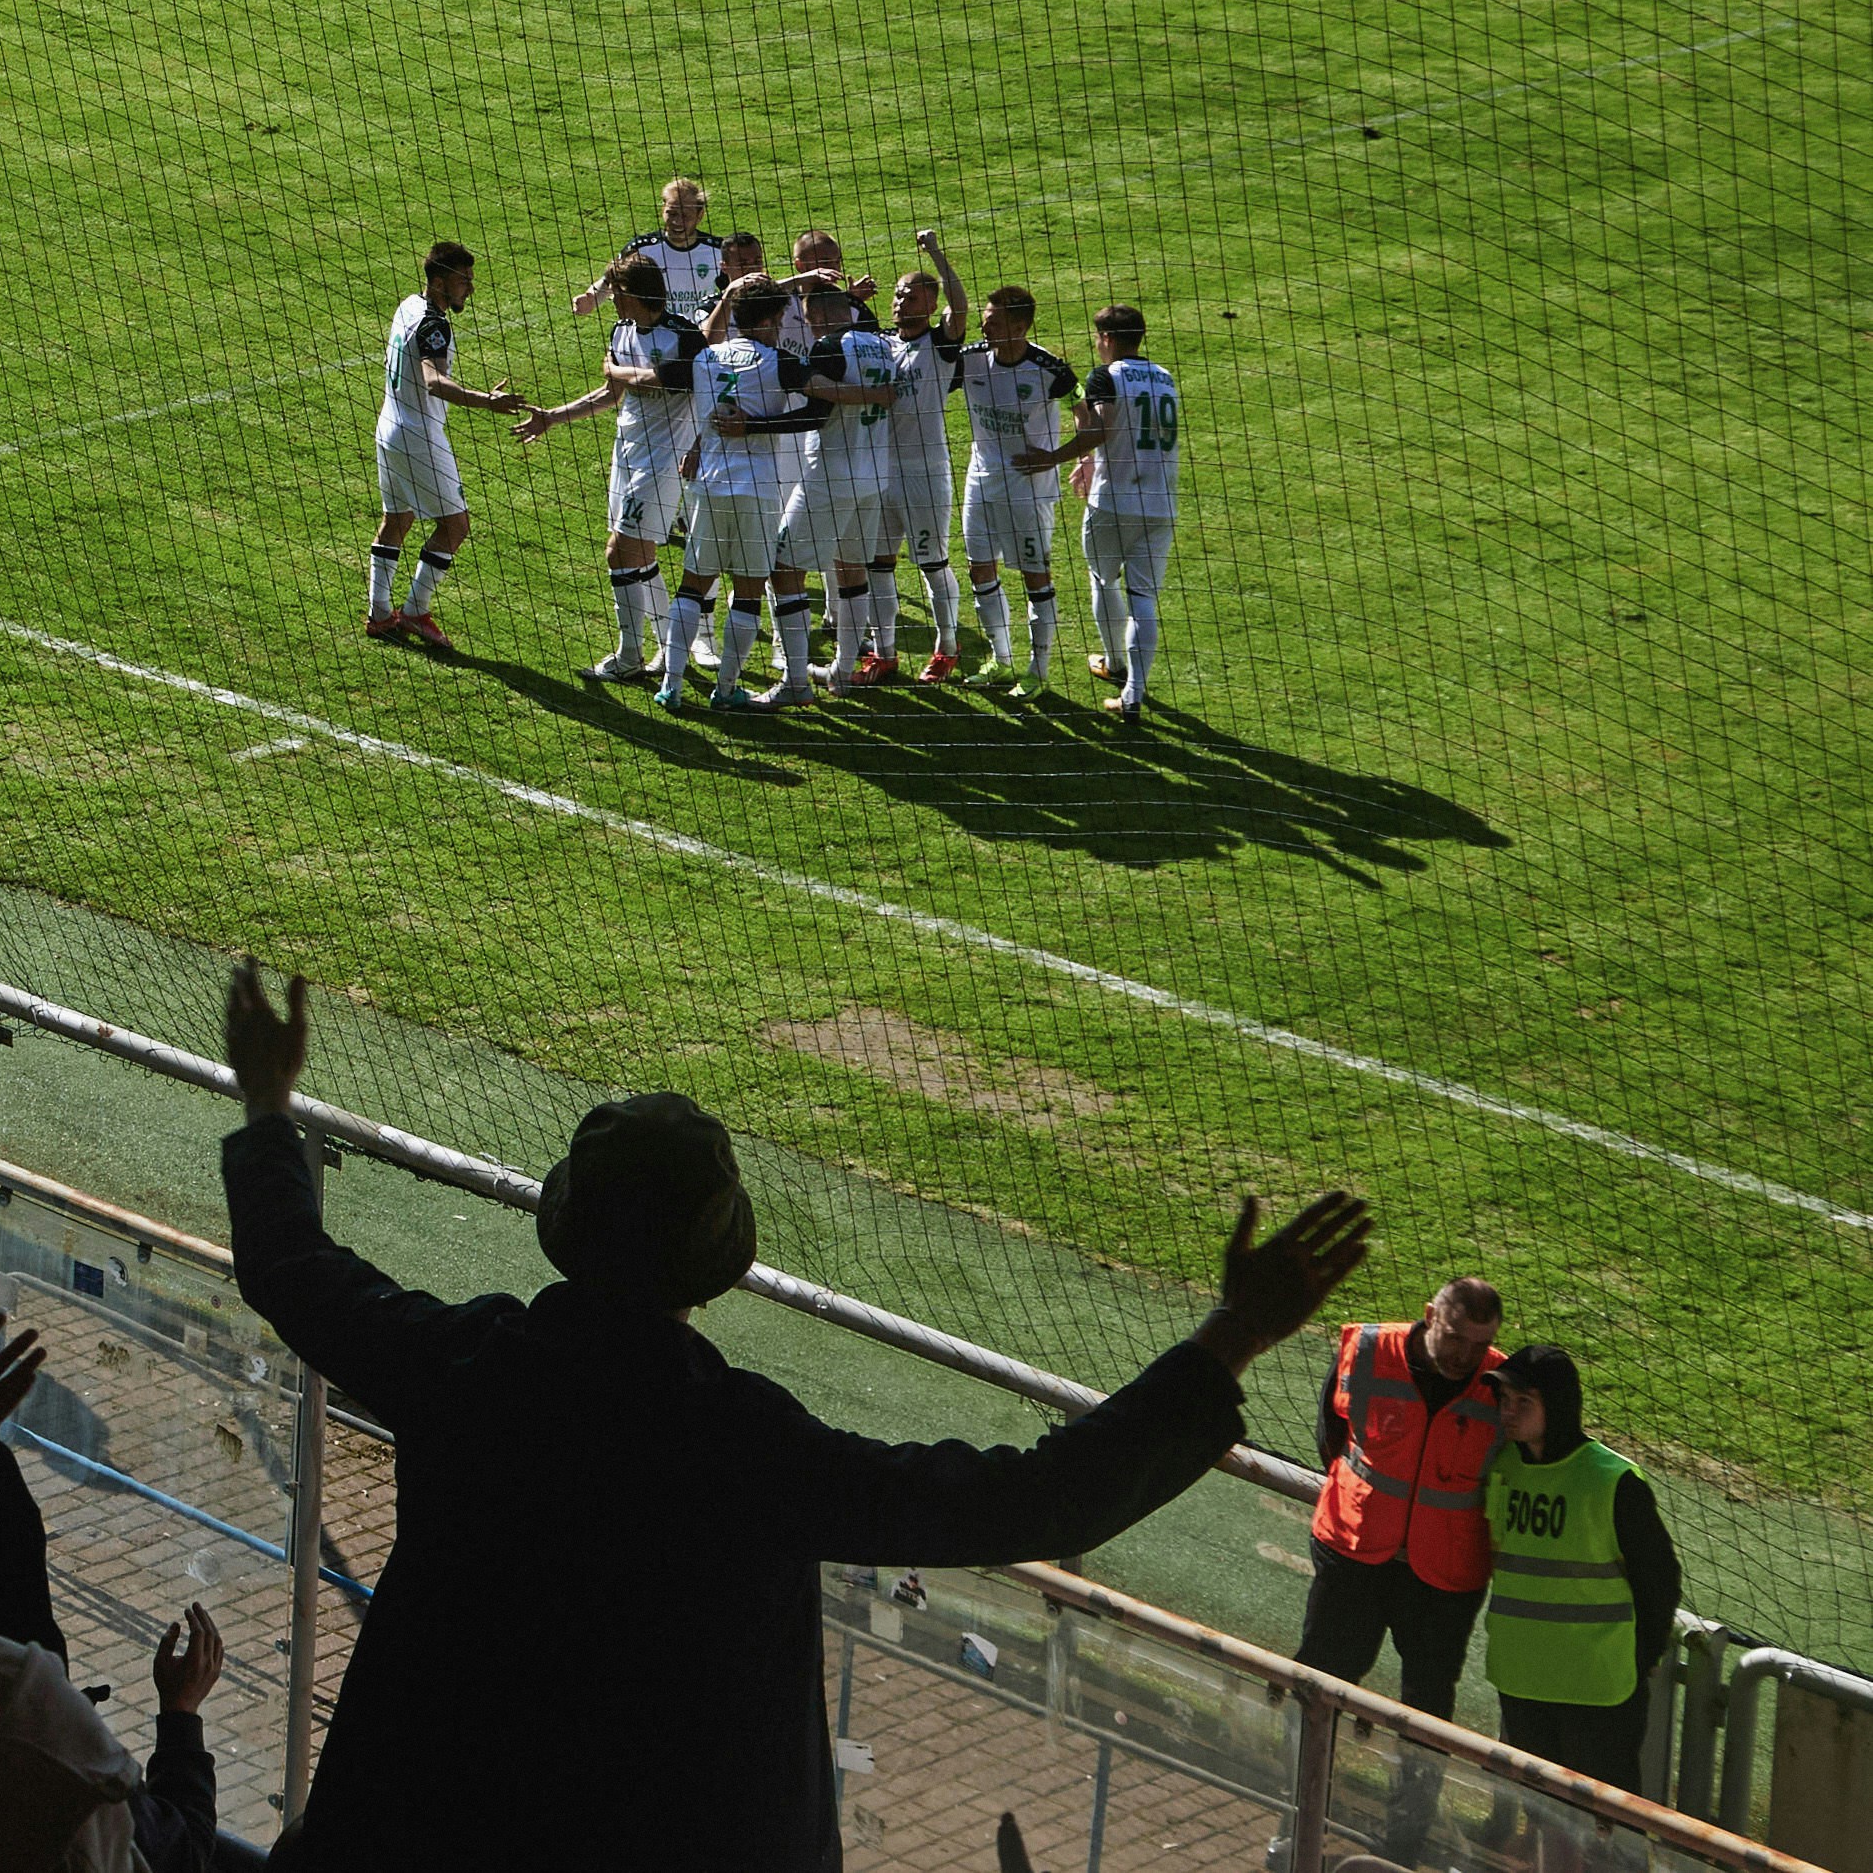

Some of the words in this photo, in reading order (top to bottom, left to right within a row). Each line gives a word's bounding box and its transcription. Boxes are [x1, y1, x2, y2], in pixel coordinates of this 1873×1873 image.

[1134, 391, 1178, 452] 19
[917, 528, 931, 551] 2
[1024, 537, 1036, 560] 5
[1506, 1488, 1567, 1540] 5060
